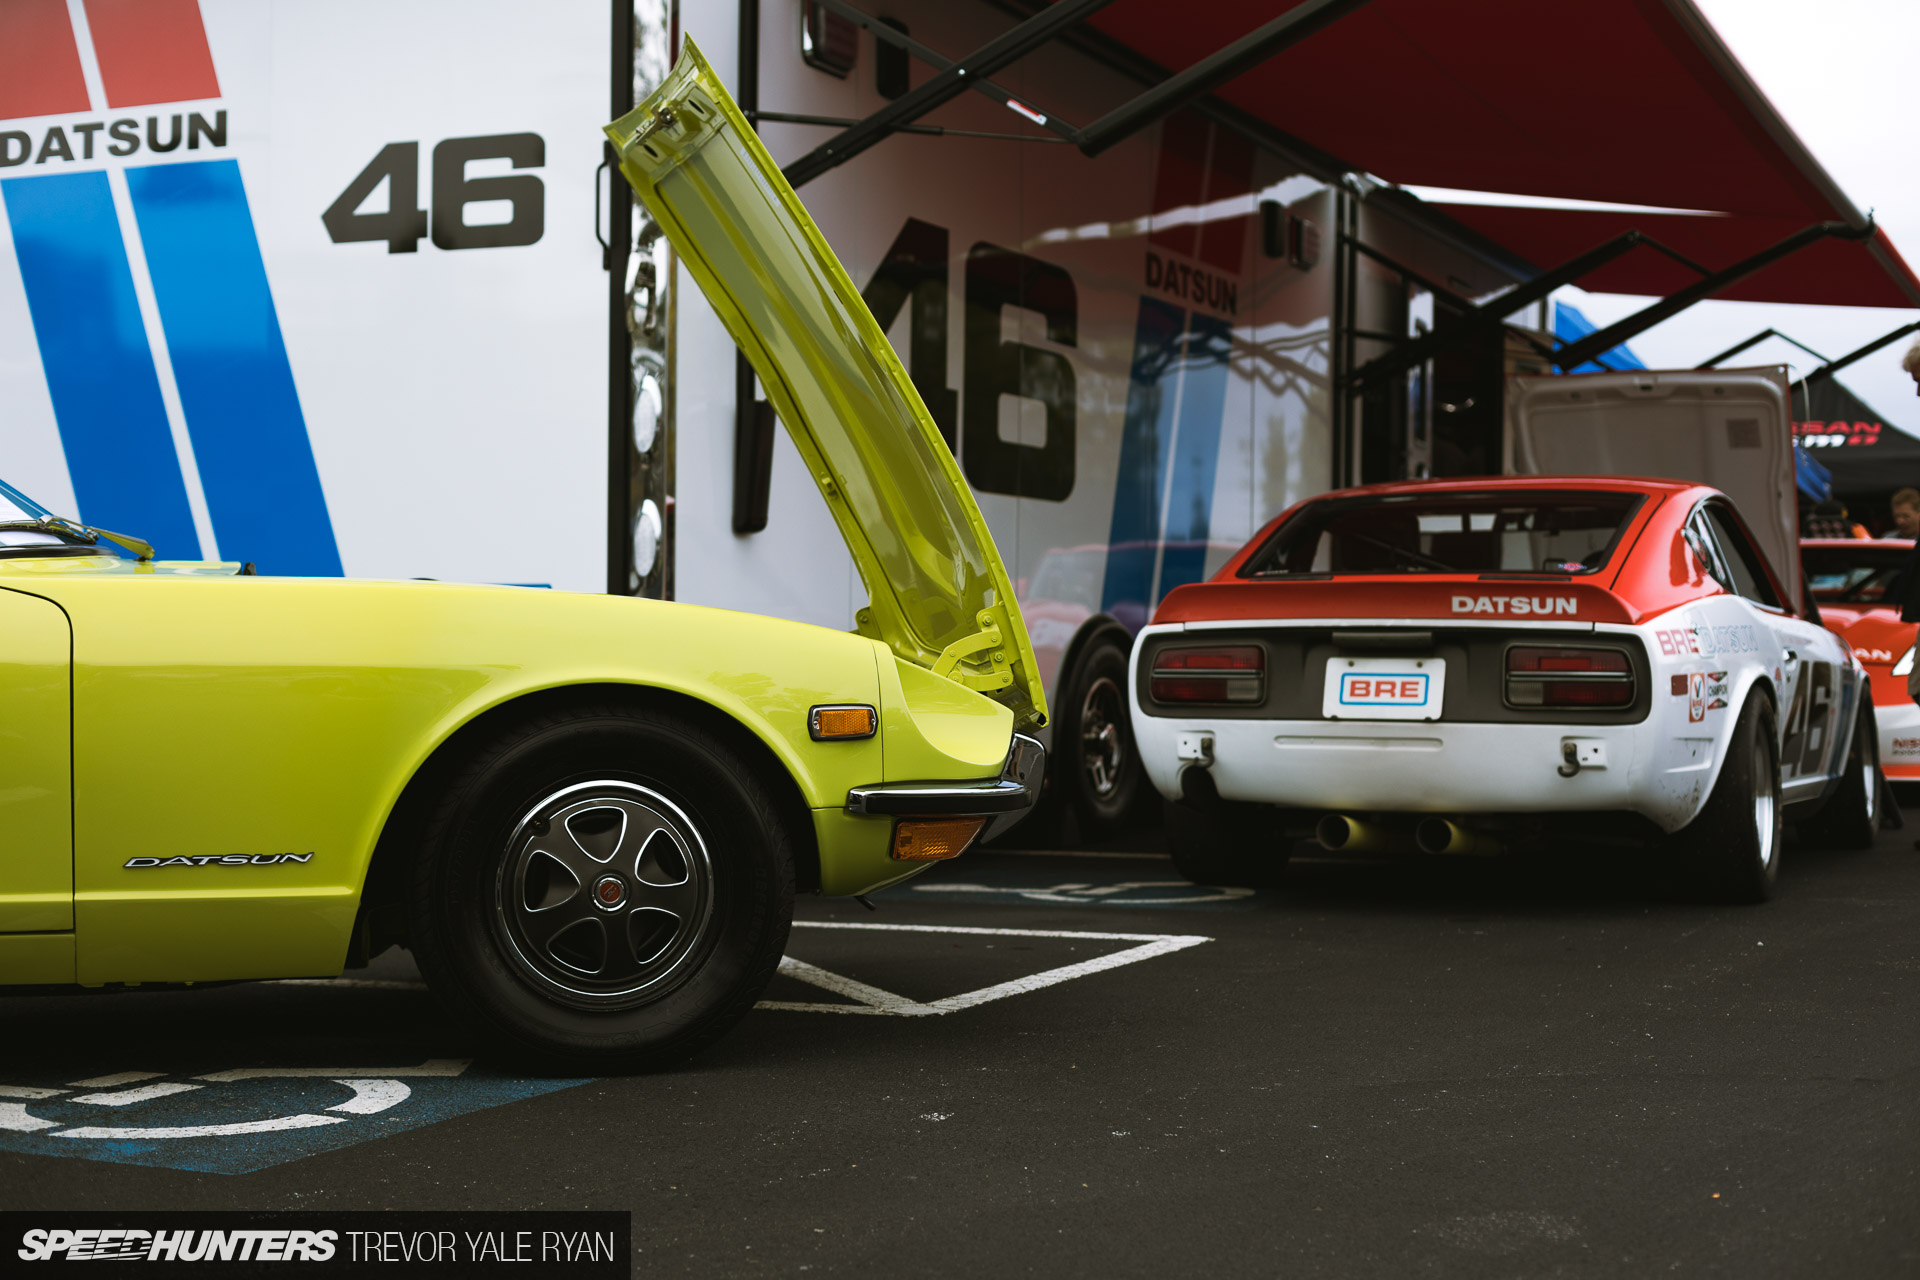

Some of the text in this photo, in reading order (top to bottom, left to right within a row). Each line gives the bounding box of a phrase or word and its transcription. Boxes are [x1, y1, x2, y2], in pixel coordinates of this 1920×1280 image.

[0, 110, 227, 168] DATSUN
[321, 131, 546, 254] 46
[1146, 252, 1239, 316] DATSUN
[1451, 595, 1578, 615] DATSUN
[1656, 625, 1759, 655] BRE DATSUN
[1348, 680, 1421, 699] BRE
[1781, 660, 1832, 777] 46
[122, 850, 315, 870] DATSUN
